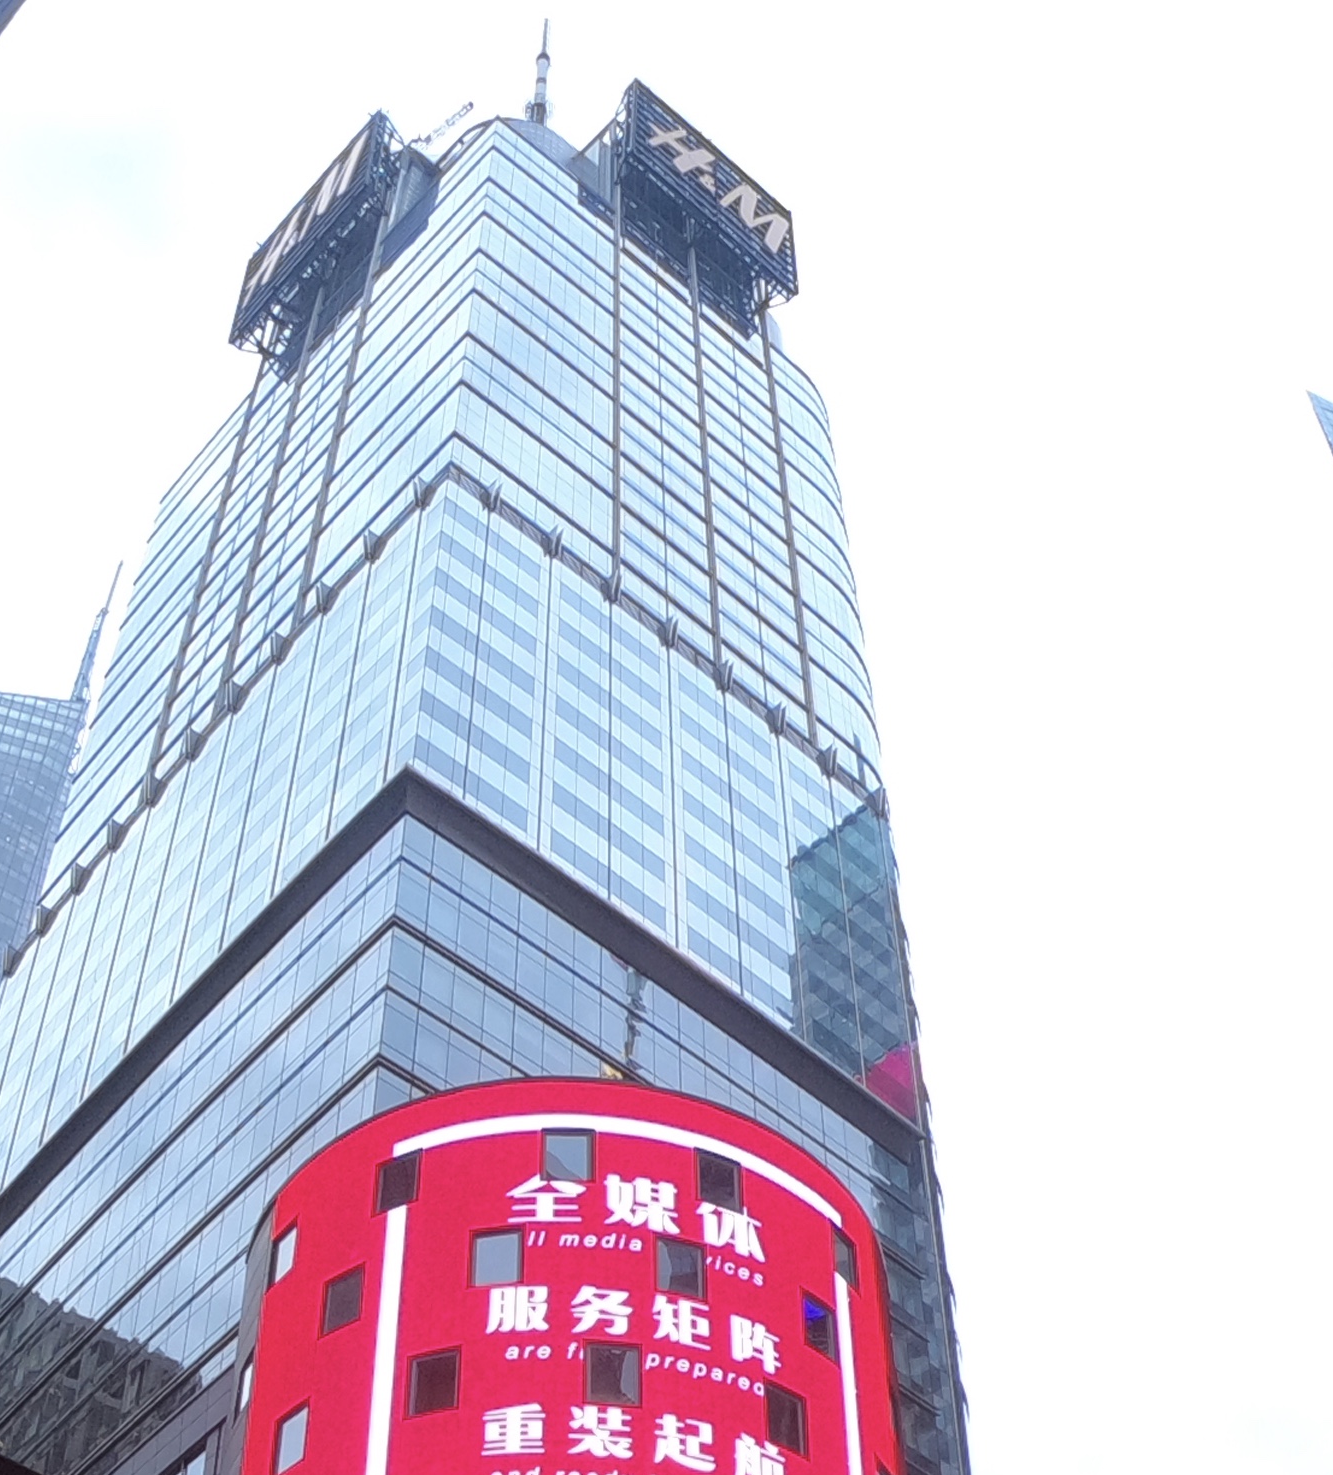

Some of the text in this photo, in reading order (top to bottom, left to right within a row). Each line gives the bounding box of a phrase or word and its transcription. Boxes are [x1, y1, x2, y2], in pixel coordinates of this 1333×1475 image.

[648, 121, 790, 253] H&M
[505, 1173, 766, 1263] 全媒体
[558, 1233, 644, 1252] media
[485, 1284, 782, 1376] 服务矩阵
[504, 1344, 552, 1361] are
